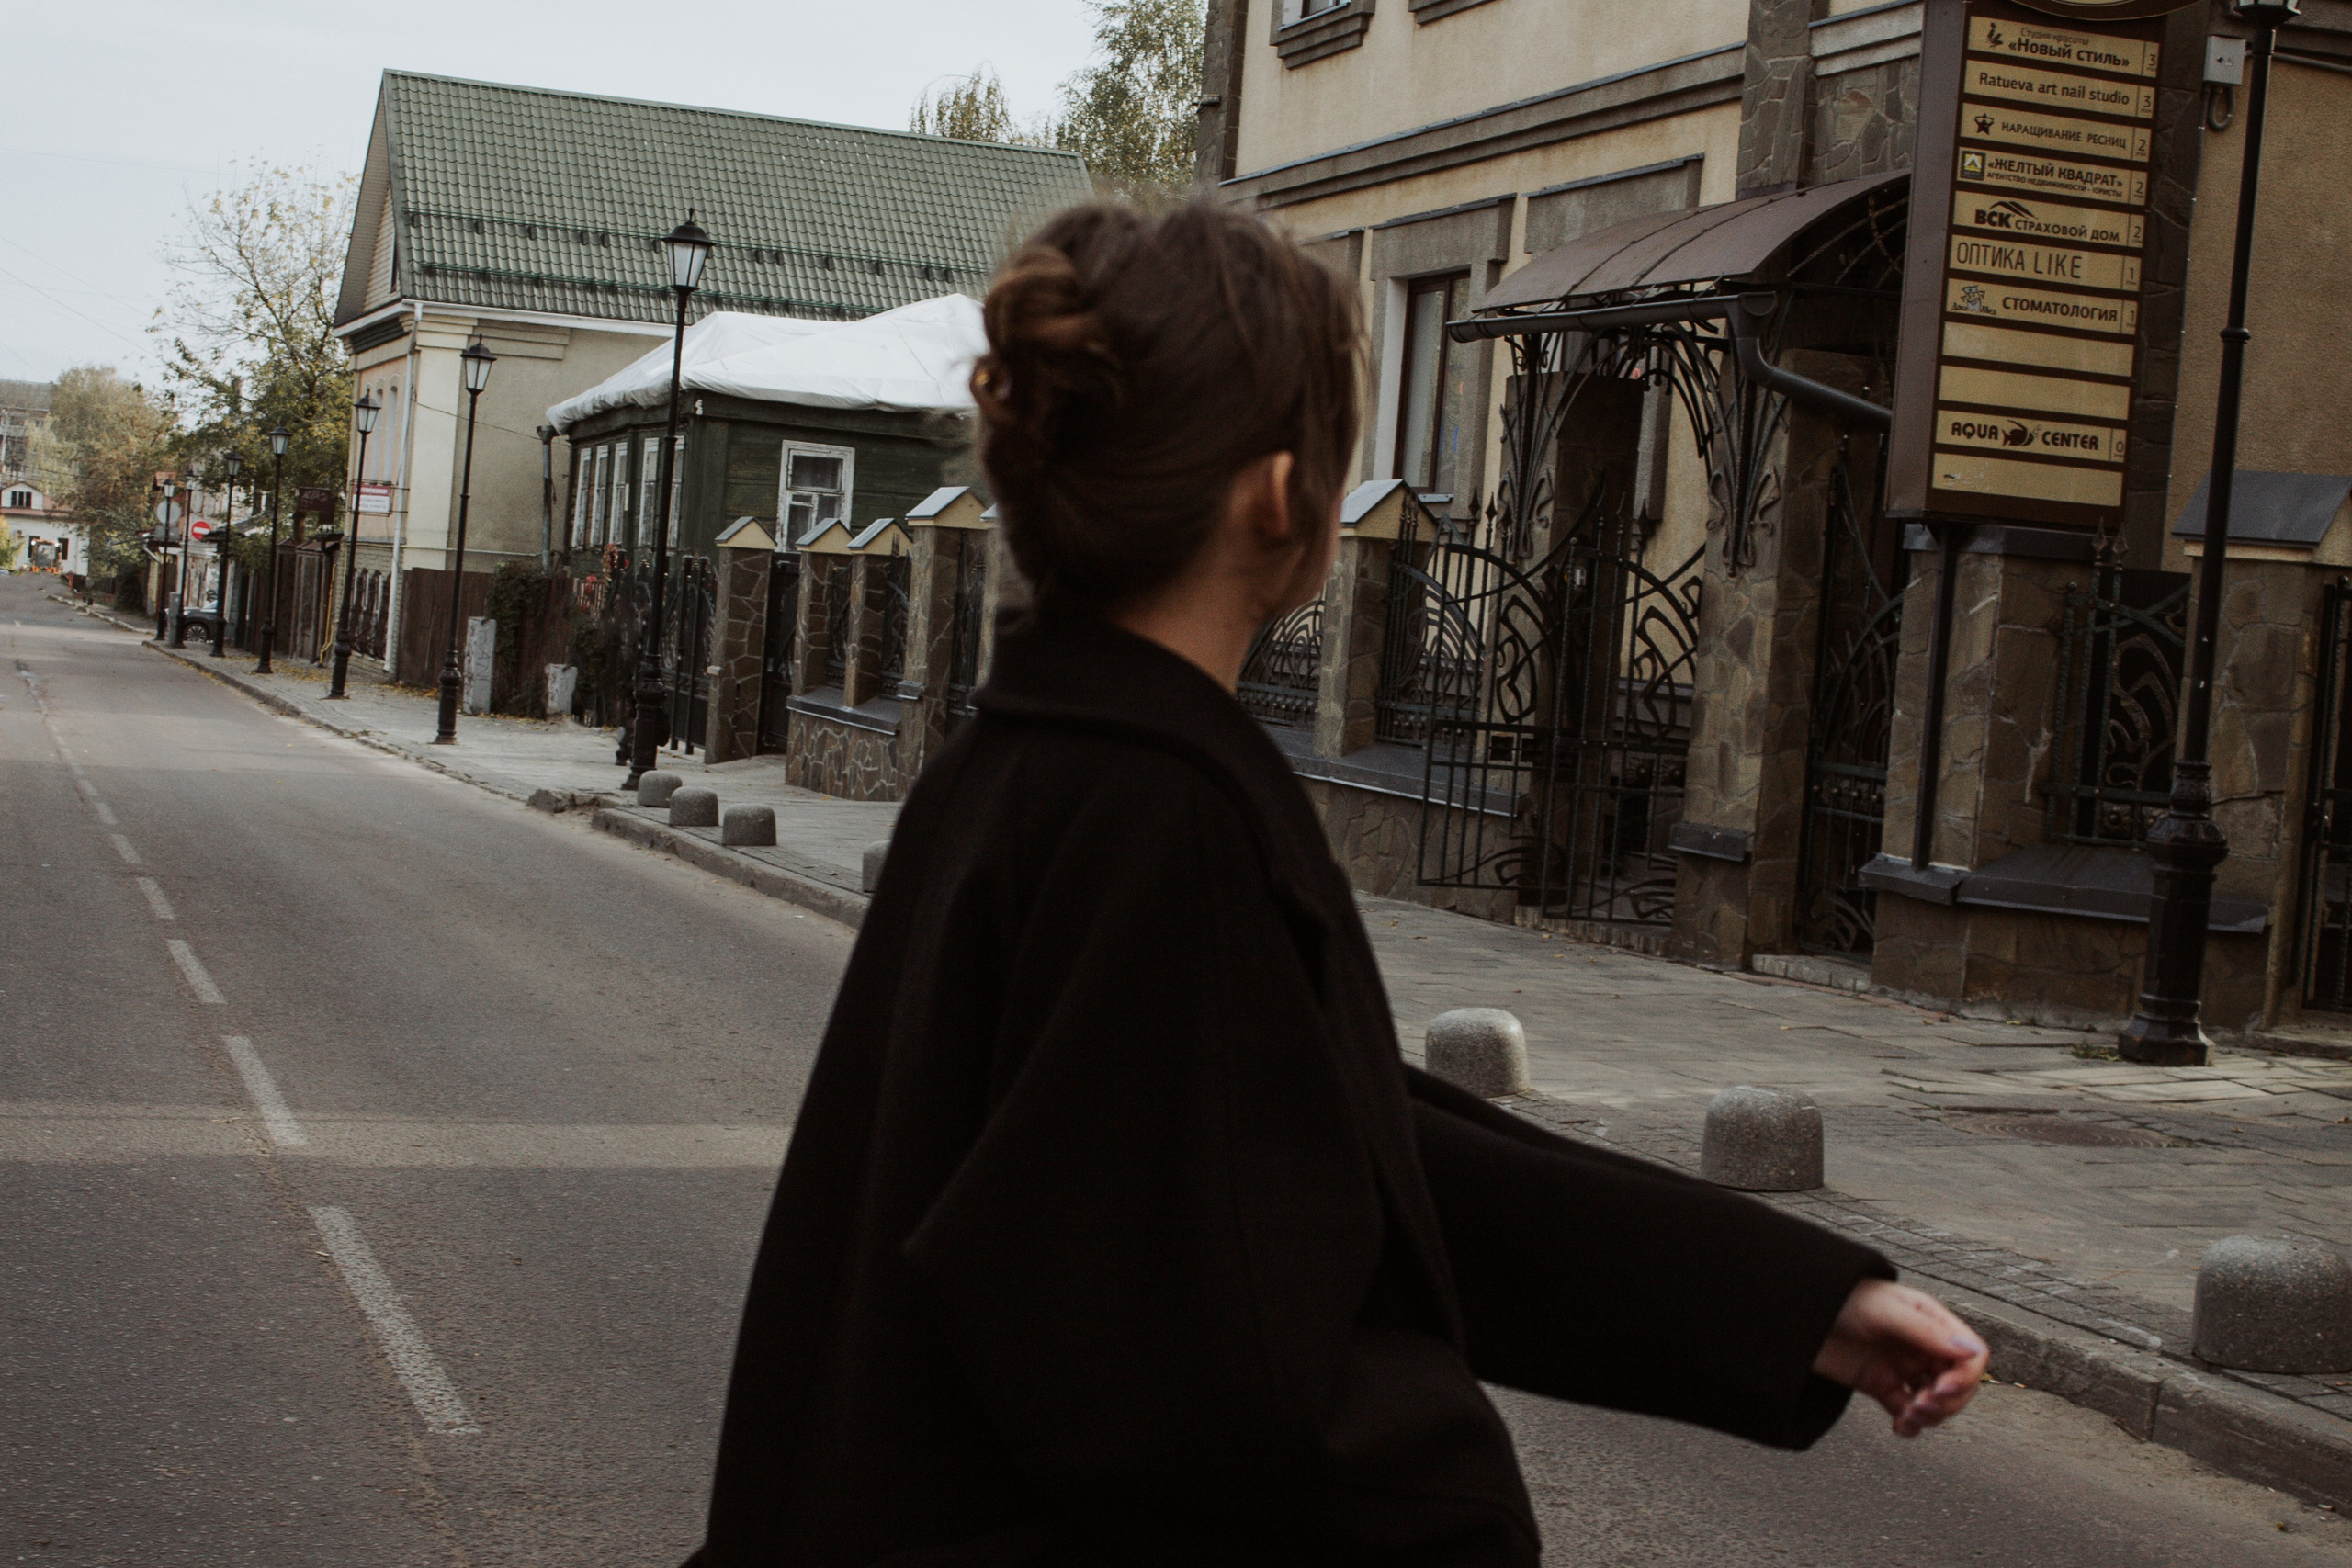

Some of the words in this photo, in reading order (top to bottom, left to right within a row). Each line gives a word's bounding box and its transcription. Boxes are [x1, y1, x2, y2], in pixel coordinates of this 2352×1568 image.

[2148, 53, 2156, 67] 3
[1979, 72, 2034, 92] Ratueva
[2038, 84, 2057, 96] art
[2061, 85, 2086, 99] nail
[2088, 88, 2130, 106] studio
[2142, 95, 2152, 108] 3
[2001, 121, 2082, 142] НАРАЩИВАНИЕ
[2086, 133, 2127, 150] РЕСНИЦ
[2137, 139, 2146, 152] 2
[1986, 171, 2026, 184] АГЕНТСТВО
[1987, 157, 2054, 178] «ЖЕЛТЫЙ
[2058, 165, 2123, 187] КВАДРАТ»
[2135, 181, 2144, 194] 2
[1975, 209, 2011, 229] ВСК
[2015, 219, 2086, 239] СТРАХОВОЙ
[2090, 229, 2120, 243] ДОМ
[2132, 225, 2142, 238] 2
[1956, 241, 2025, 272] ОПТИКА
[2033, 251, 2083, 279] LIKE
[2129, 267, 2134, 280] 1
[2001, 296, 2118, 322] СТОМАТОЛОГИЯ
[1951, 421, 1999, 441] AQUA
[2041, 430, 2099, 451] CENTER
[2115, 441, 2124, 453] 0
